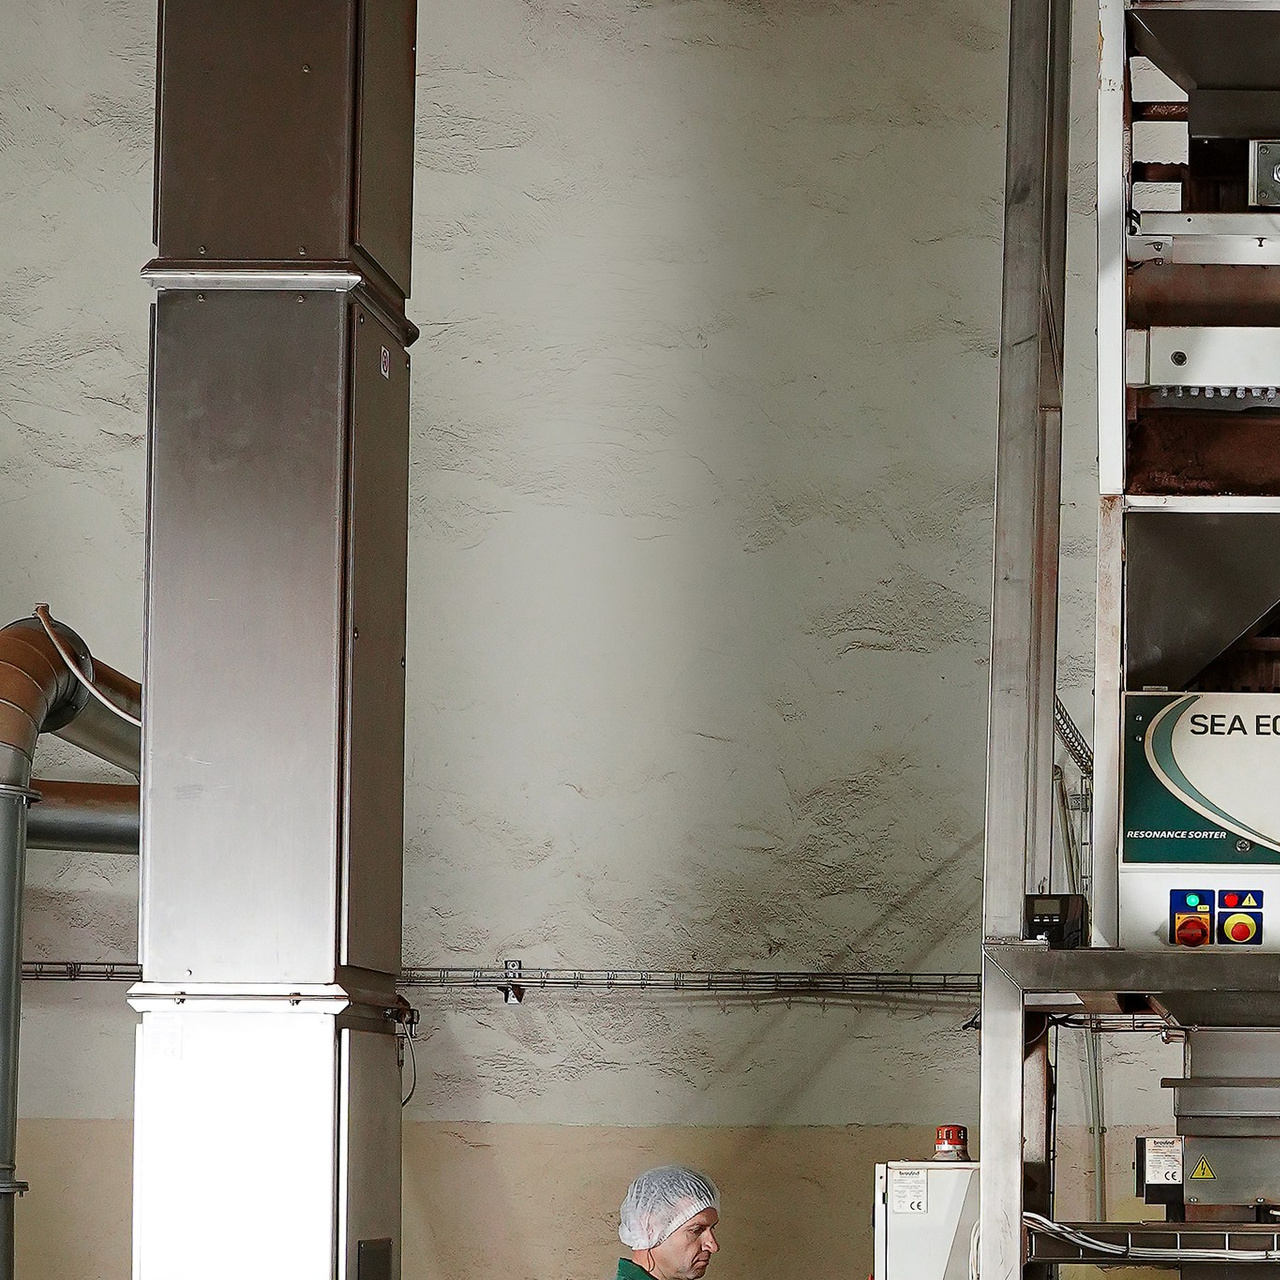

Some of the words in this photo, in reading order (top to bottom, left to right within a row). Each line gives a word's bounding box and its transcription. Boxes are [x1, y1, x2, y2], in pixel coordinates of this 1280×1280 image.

[1190, 714, 1247, 736] SEA
[1126, 830, 1187, 839] RESONANCE
[1187, 830, 1227, 839] SORTER
